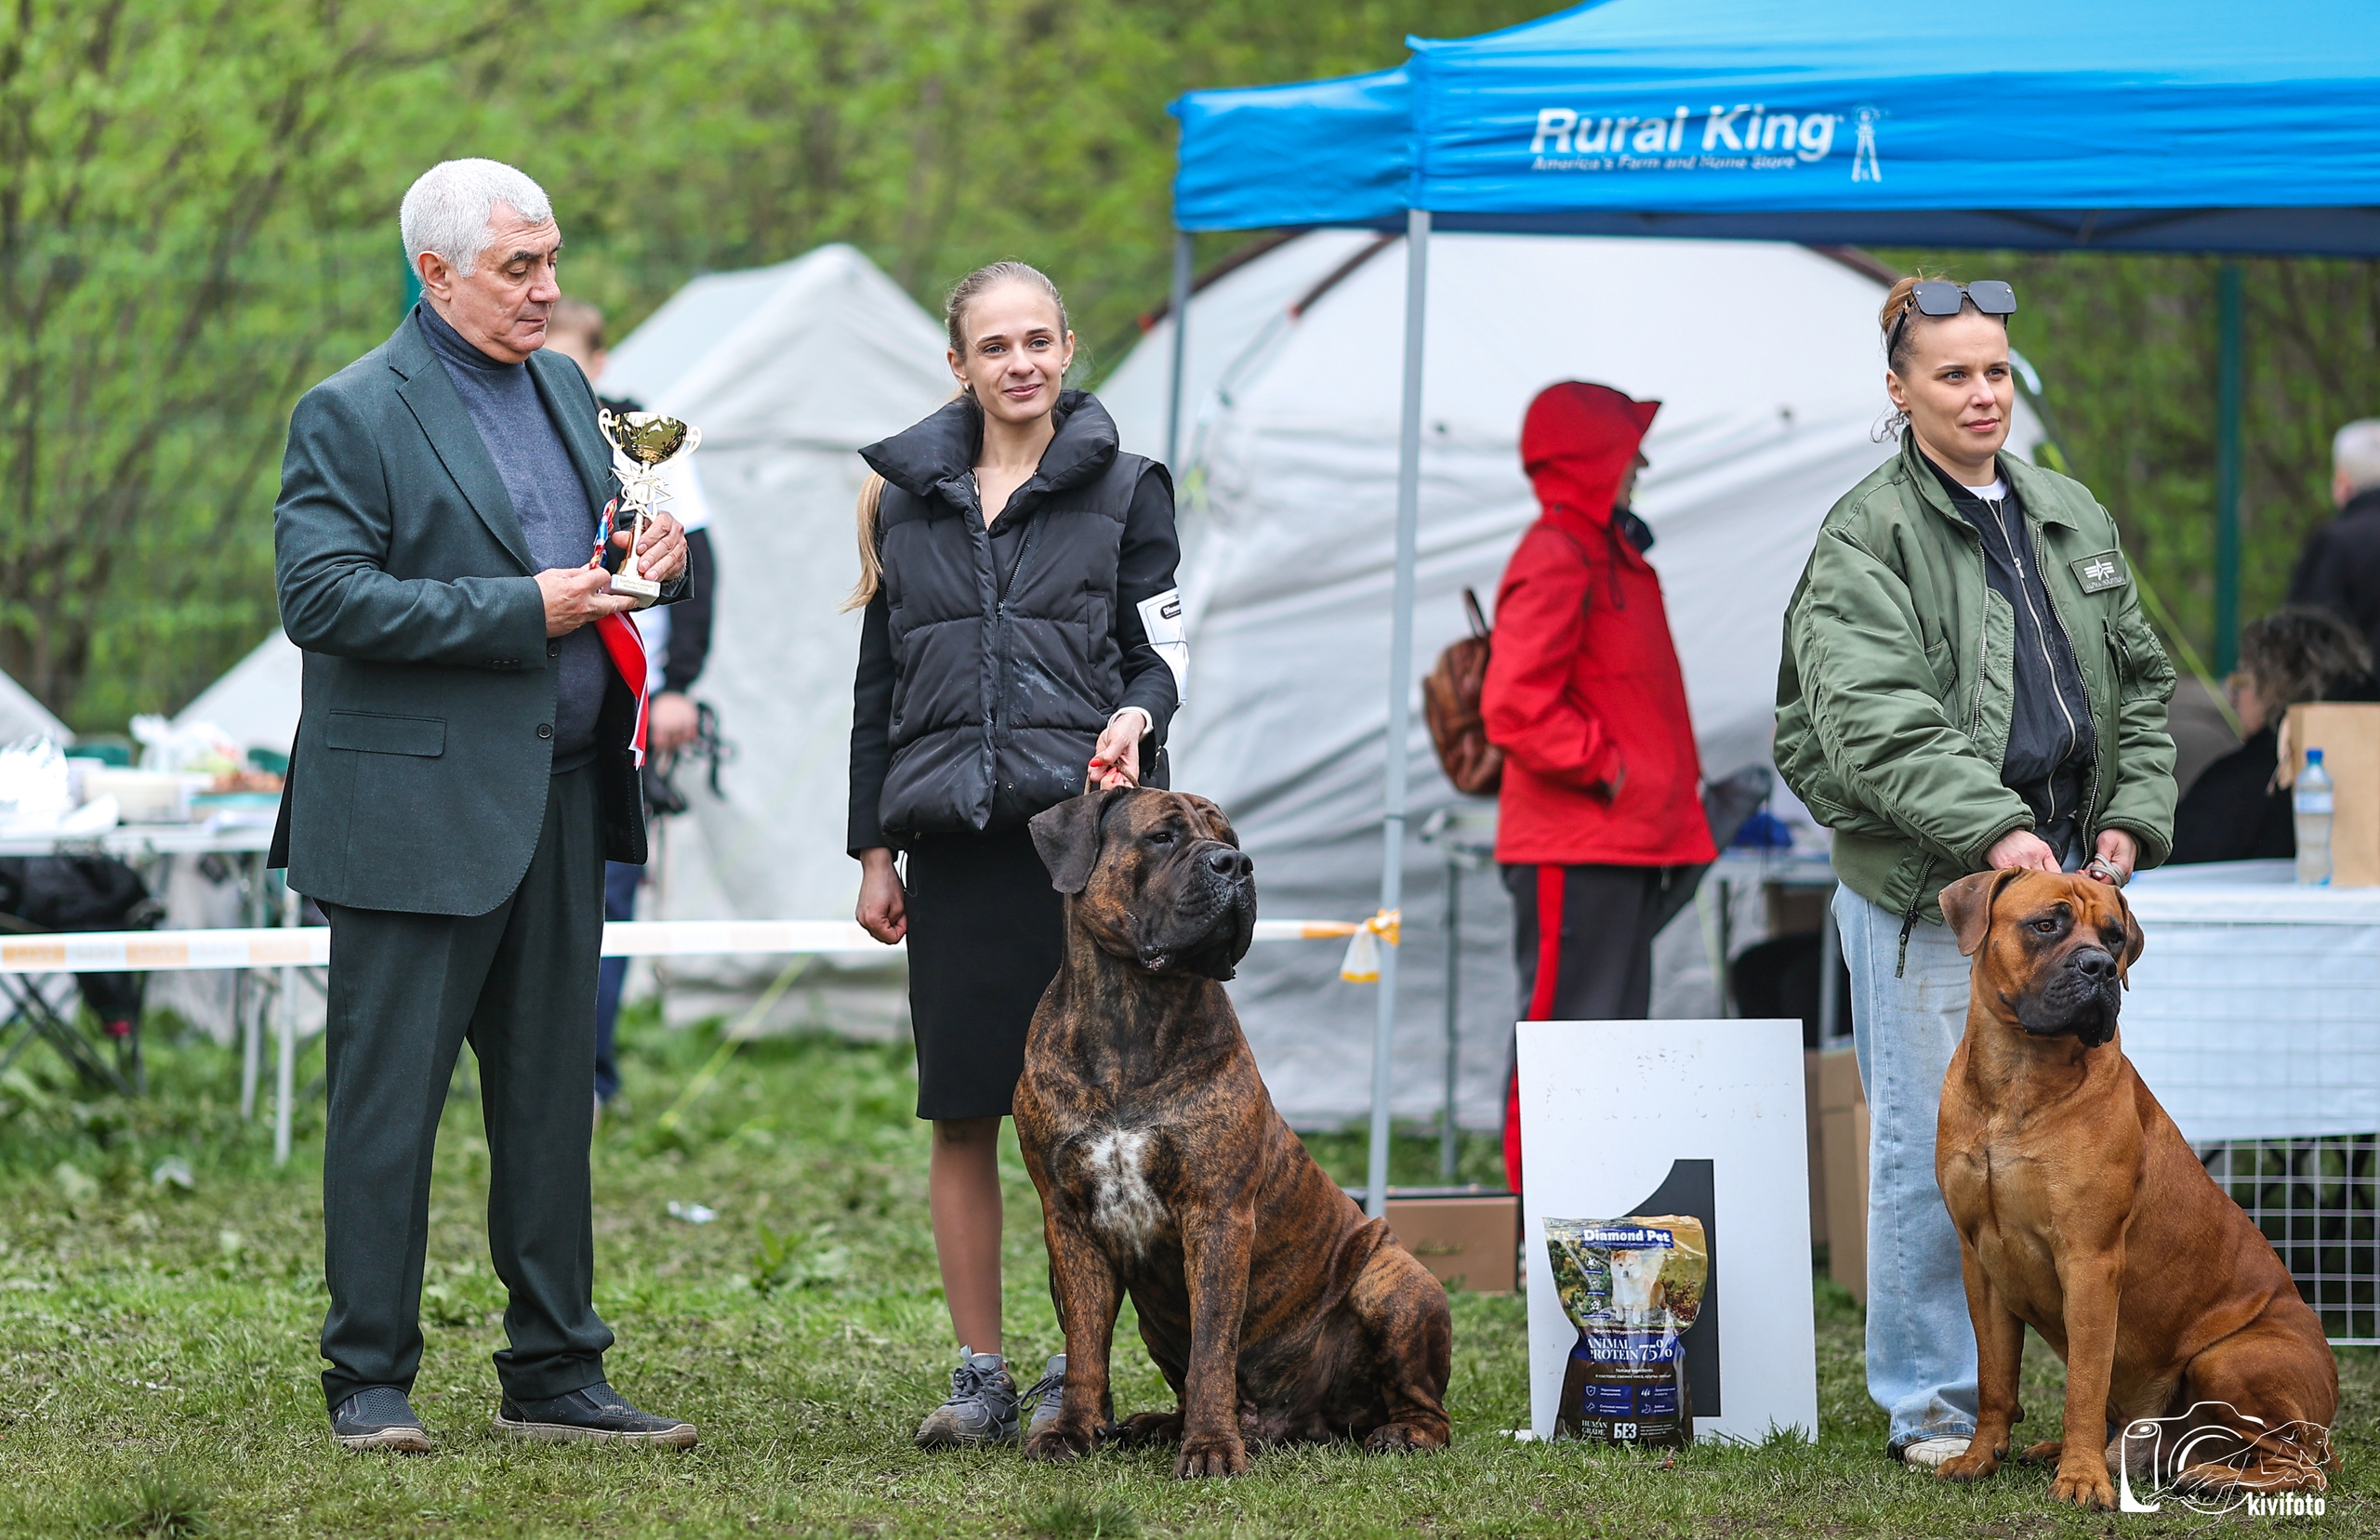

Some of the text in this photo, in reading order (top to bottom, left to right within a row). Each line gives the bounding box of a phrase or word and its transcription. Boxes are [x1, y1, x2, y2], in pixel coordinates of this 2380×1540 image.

[1529, 103, 1837, 162] Rural King
[1618, 154, 1660, 169] Farm
[1667, 153, 1696, 169] and
[1699, 152, 1748, 168] Home
[1752, 153, 1796, 169] Store
[1583, 1229, 1671, 1242] Diamond Pet
[1587, 1338, 1632, 1349] ANIMAL
[1638, 1337, 1673, 1362] 75%
[1581, 1419, 1608, 1428] HUMAN
[1613, 1422, 1637, 1440] БЕЗ
